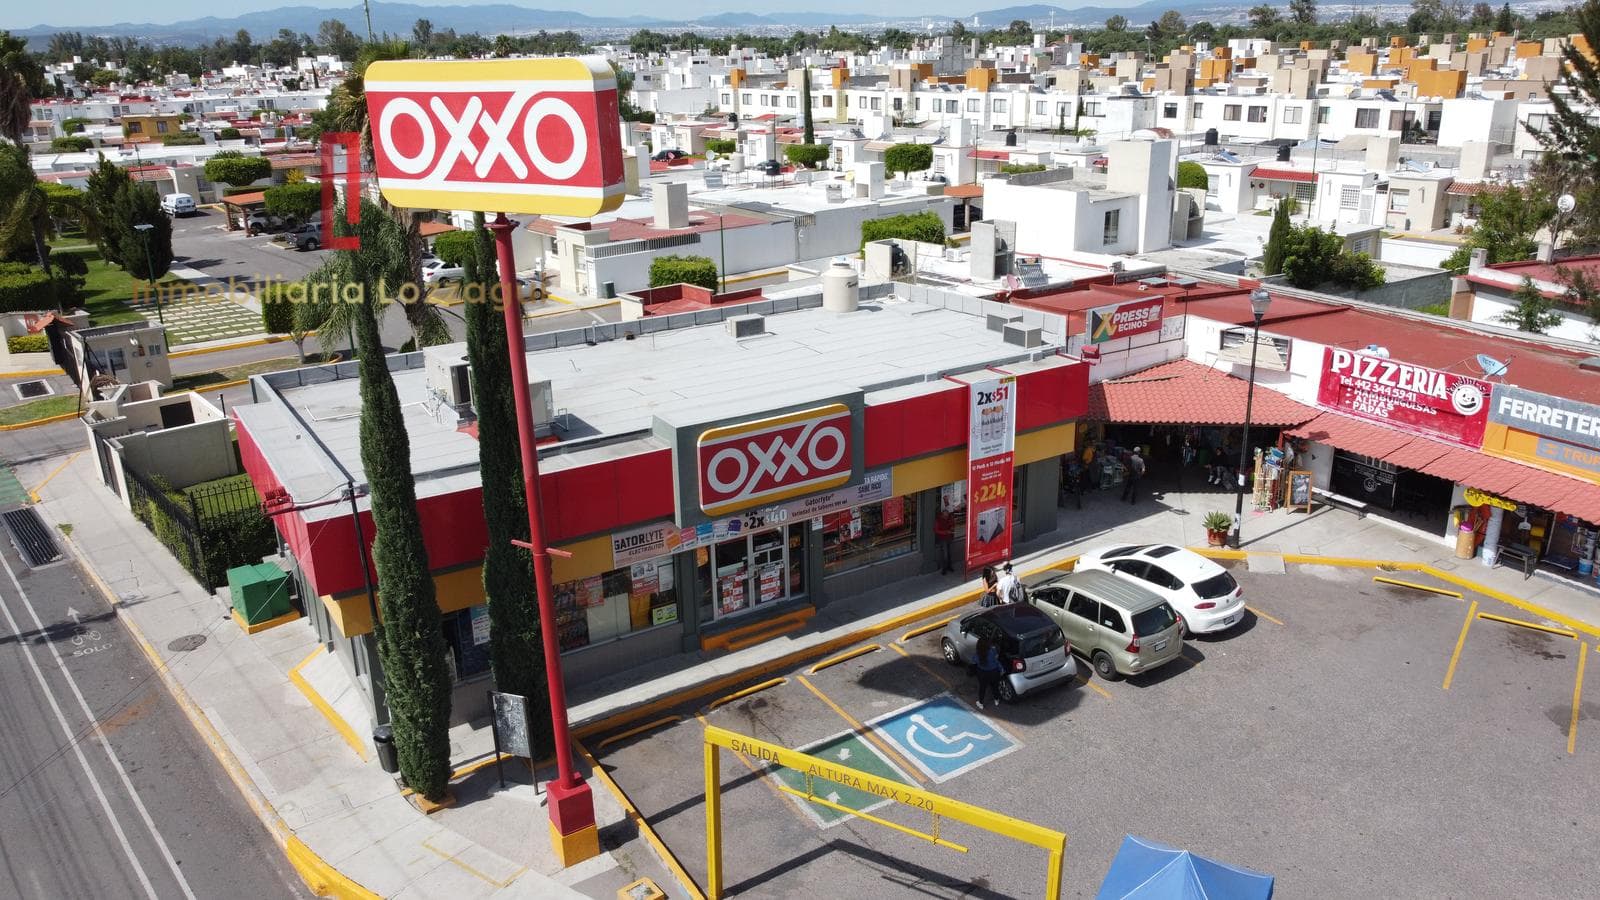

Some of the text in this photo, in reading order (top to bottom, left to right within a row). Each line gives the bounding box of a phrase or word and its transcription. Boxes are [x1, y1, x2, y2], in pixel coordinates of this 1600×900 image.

[379, 92, 588, 181] OXXO
[1331, 350, 1449, 400] PIZZERIA
[1340, 375, 1417, 402] Tel. 442 344 5941
[1352, 401, 1389, 418] PAPAS
[1355, 395, 1394, 411] ALITAS
[707, 423, 846, 497] OXXO
[974, 481, 1007, 503] $224
[614, 528, 665, 551] GATORLYTE
[73, 643, 112, 657] SOLO
[731, 739, 934, 811] SALIDA ALTURA MAX 2.20
